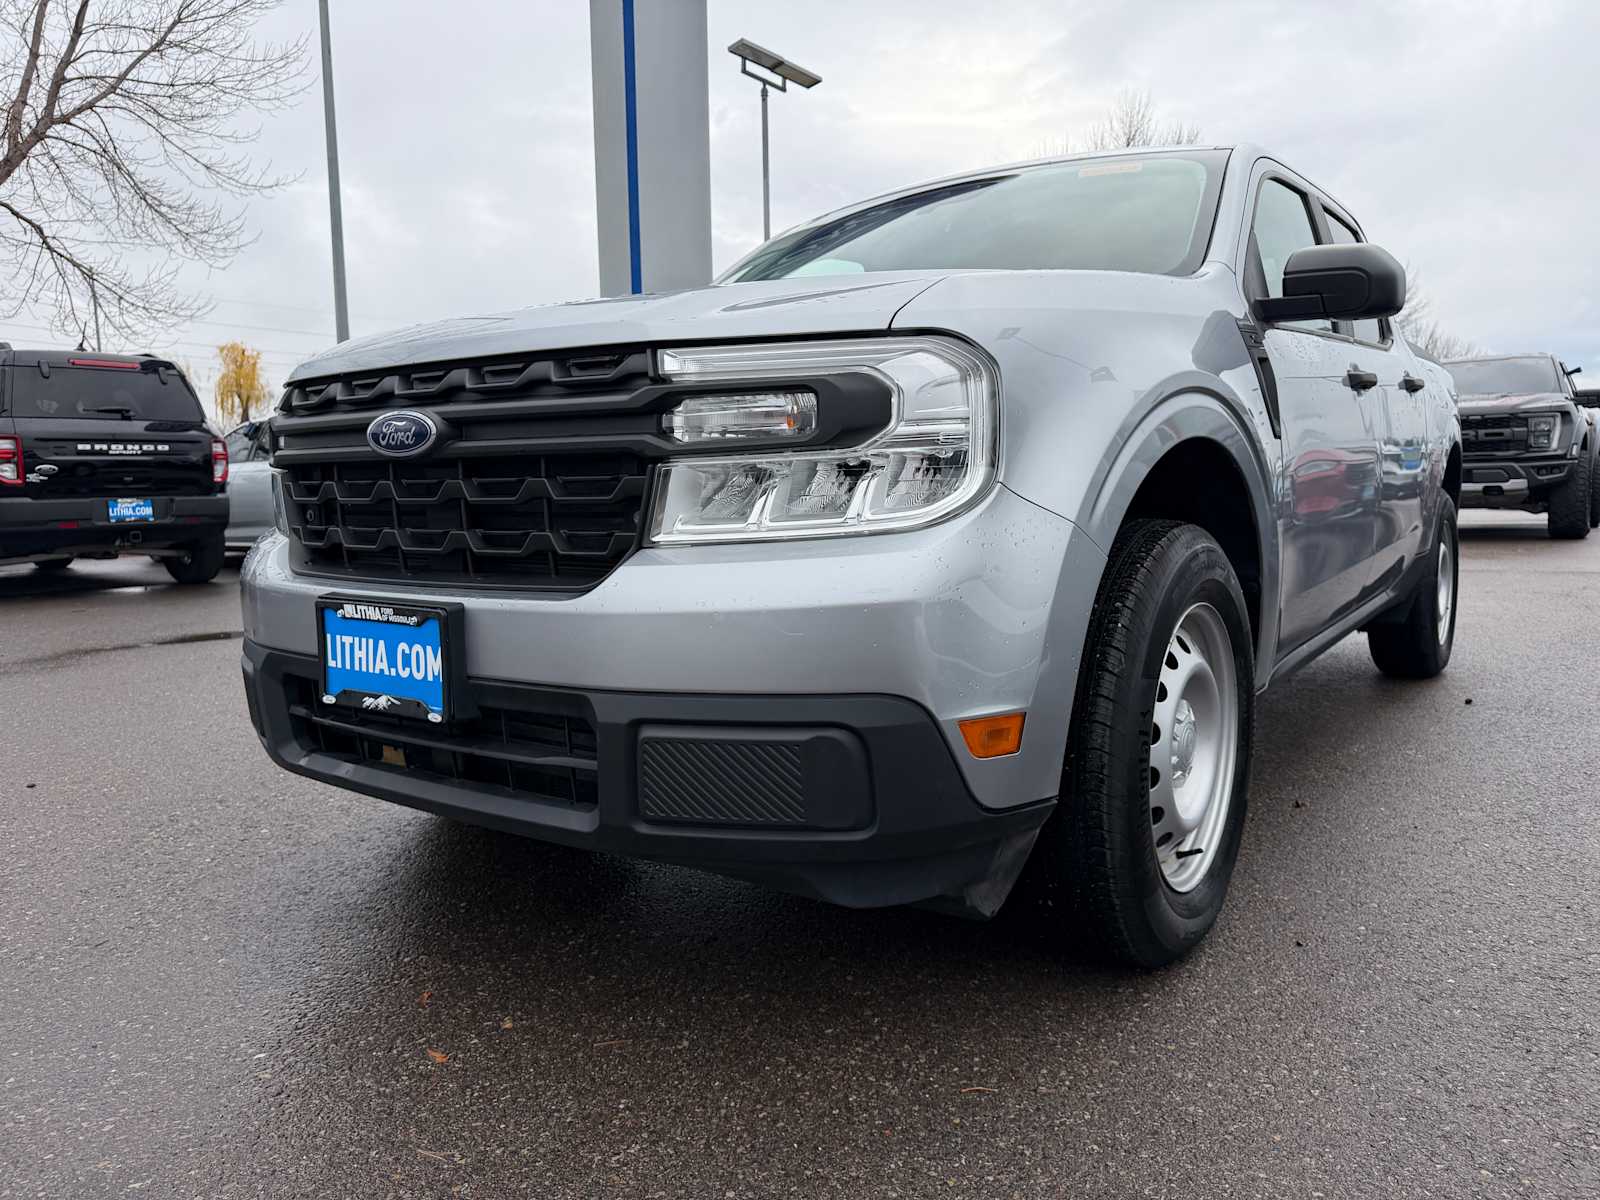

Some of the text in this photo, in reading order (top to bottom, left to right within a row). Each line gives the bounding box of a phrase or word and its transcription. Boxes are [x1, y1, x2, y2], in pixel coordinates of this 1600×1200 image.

[380, 421, 416, 446] Ford
[109, 506, 153, 516] LITHIA.COM
[351, 604, 383, 621] LITHIA
[326, 633, 443, 682] LITHIA.COM
